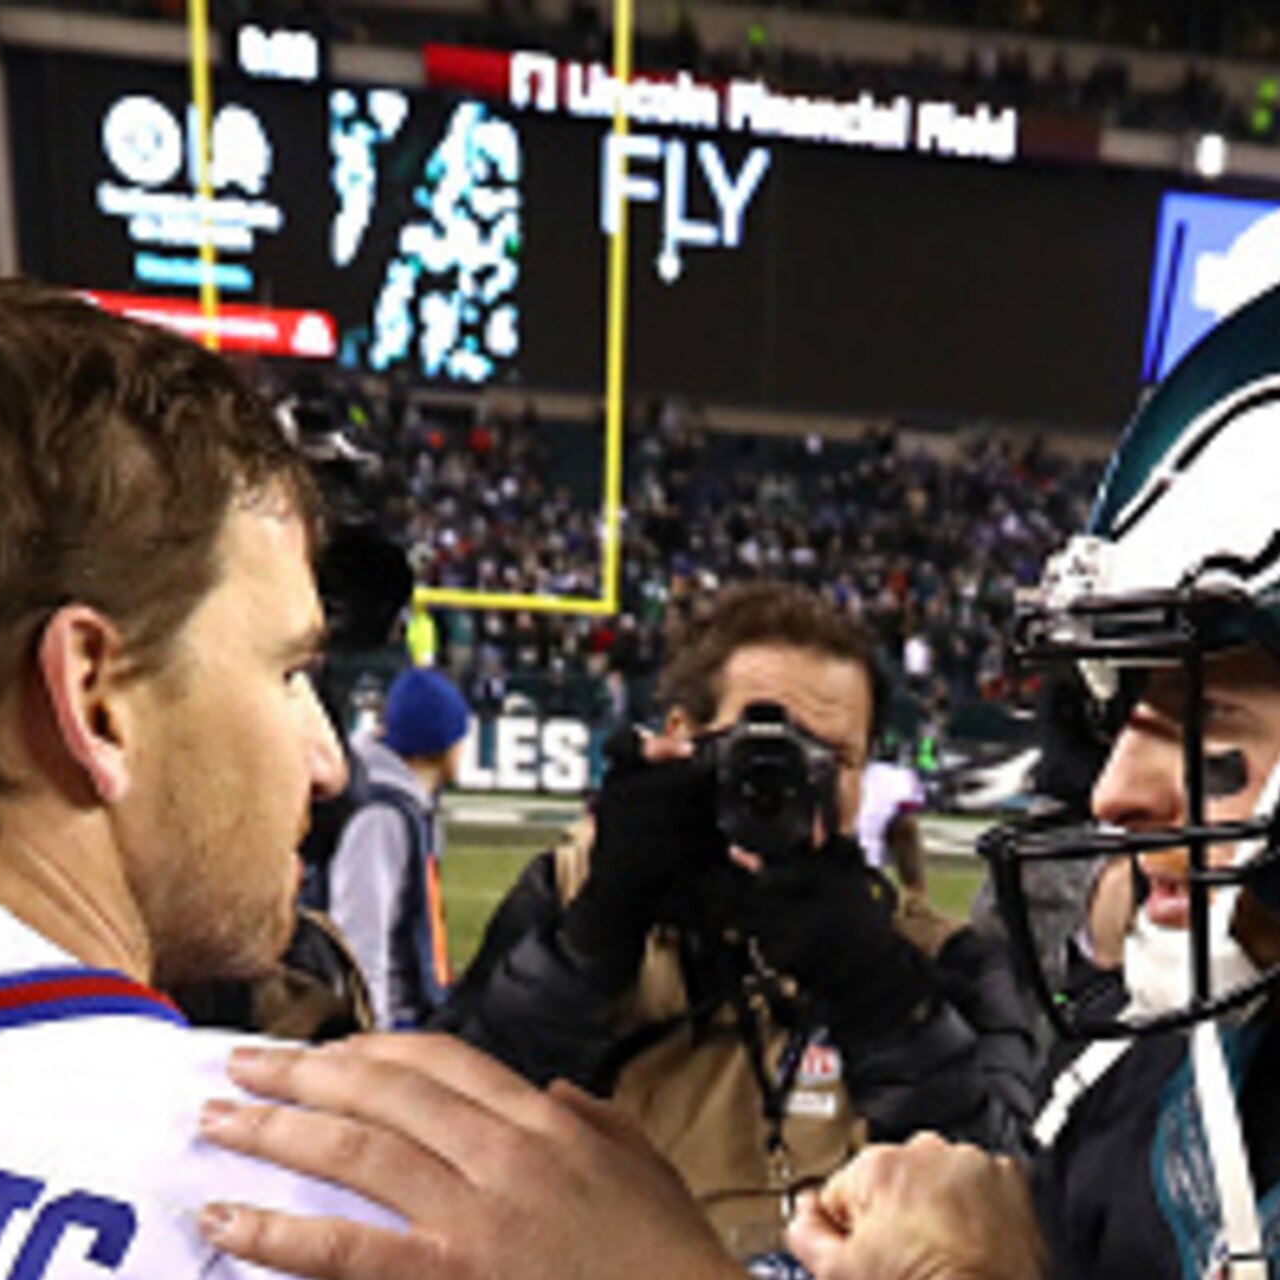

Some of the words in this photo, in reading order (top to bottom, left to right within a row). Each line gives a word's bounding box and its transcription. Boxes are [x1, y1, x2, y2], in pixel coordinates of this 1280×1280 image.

[567, 61, 719, 129] Lincoln
[727, 80, 910, 148] Financial
[917, 101, 1017, 160] Field
[601, 132, 771, 248] FLY
